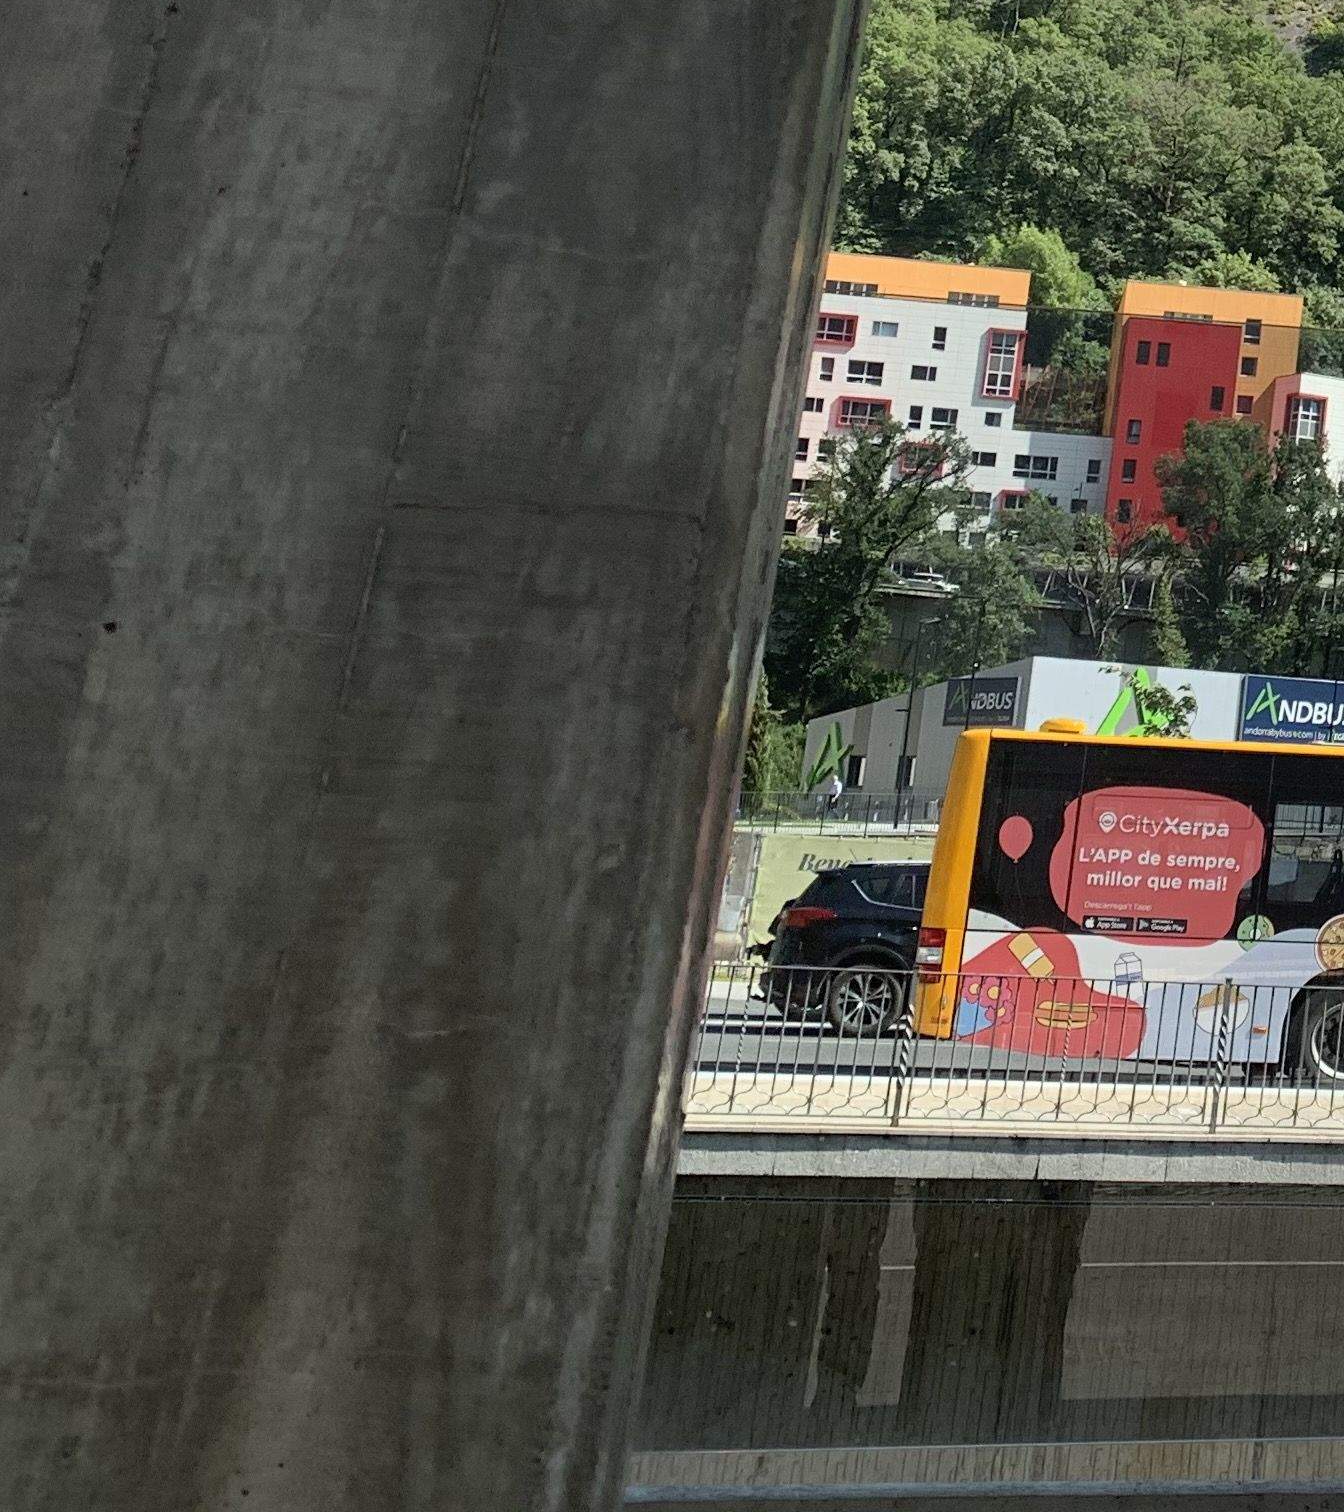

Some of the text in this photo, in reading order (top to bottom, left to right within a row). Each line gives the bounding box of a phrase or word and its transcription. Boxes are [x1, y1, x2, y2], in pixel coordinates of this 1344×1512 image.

[1119, 814, 1230, 840] CityXerpa
[1078, 847, 1241, 873] L'APP de sempre,
[1086, 870, 1228, 893] millor que mai!
[1150, 922, 1173, 933] Google
